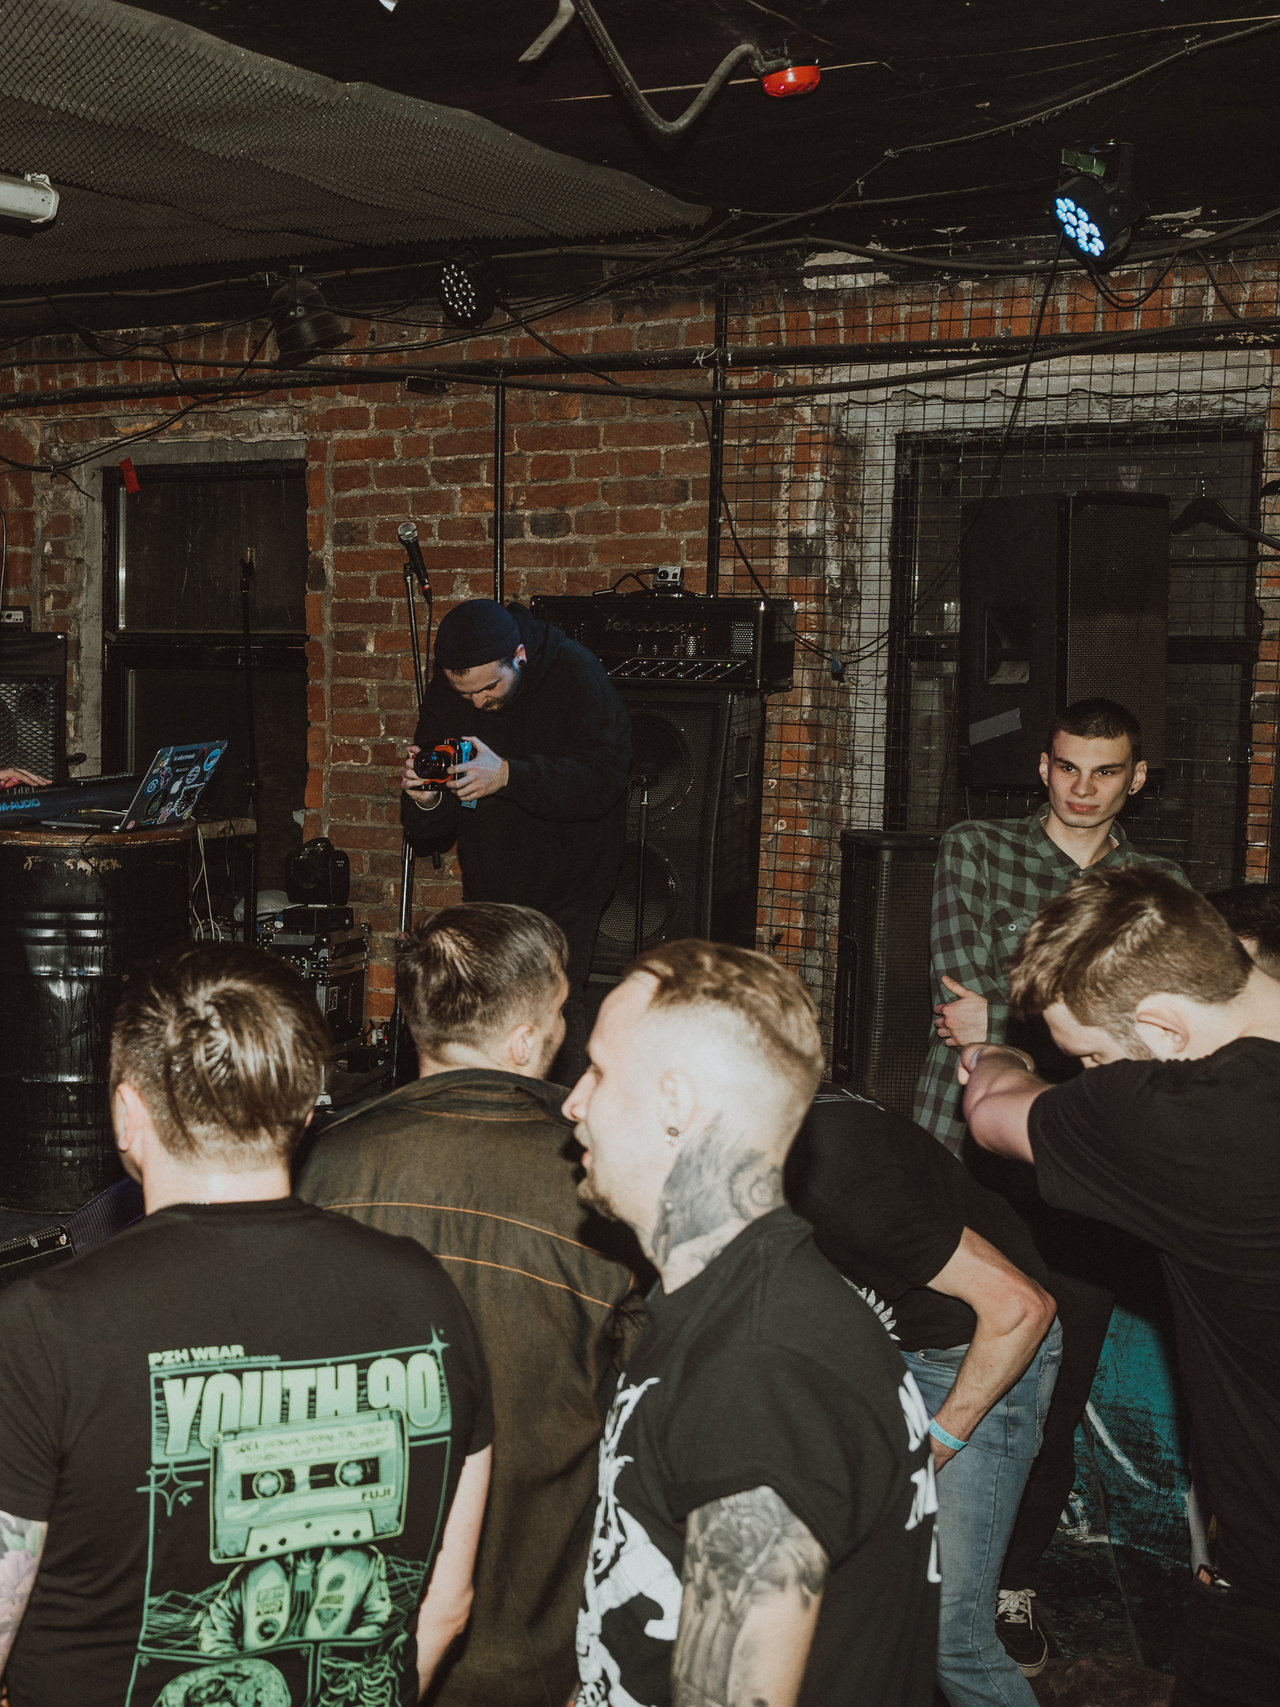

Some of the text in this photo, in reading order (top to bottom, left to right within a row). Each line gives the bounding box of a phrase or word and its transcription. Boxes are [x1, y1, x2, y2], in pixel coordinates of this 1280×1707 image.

[148, 1348, 189, 1366] PZH
[190, 1344, 245, 1361] WEAR
[162, 1363, 358, 1456] YOUTH
[367, 1351, 442, 1429] 90
[361, 1488, 391, 1500] FUJI
